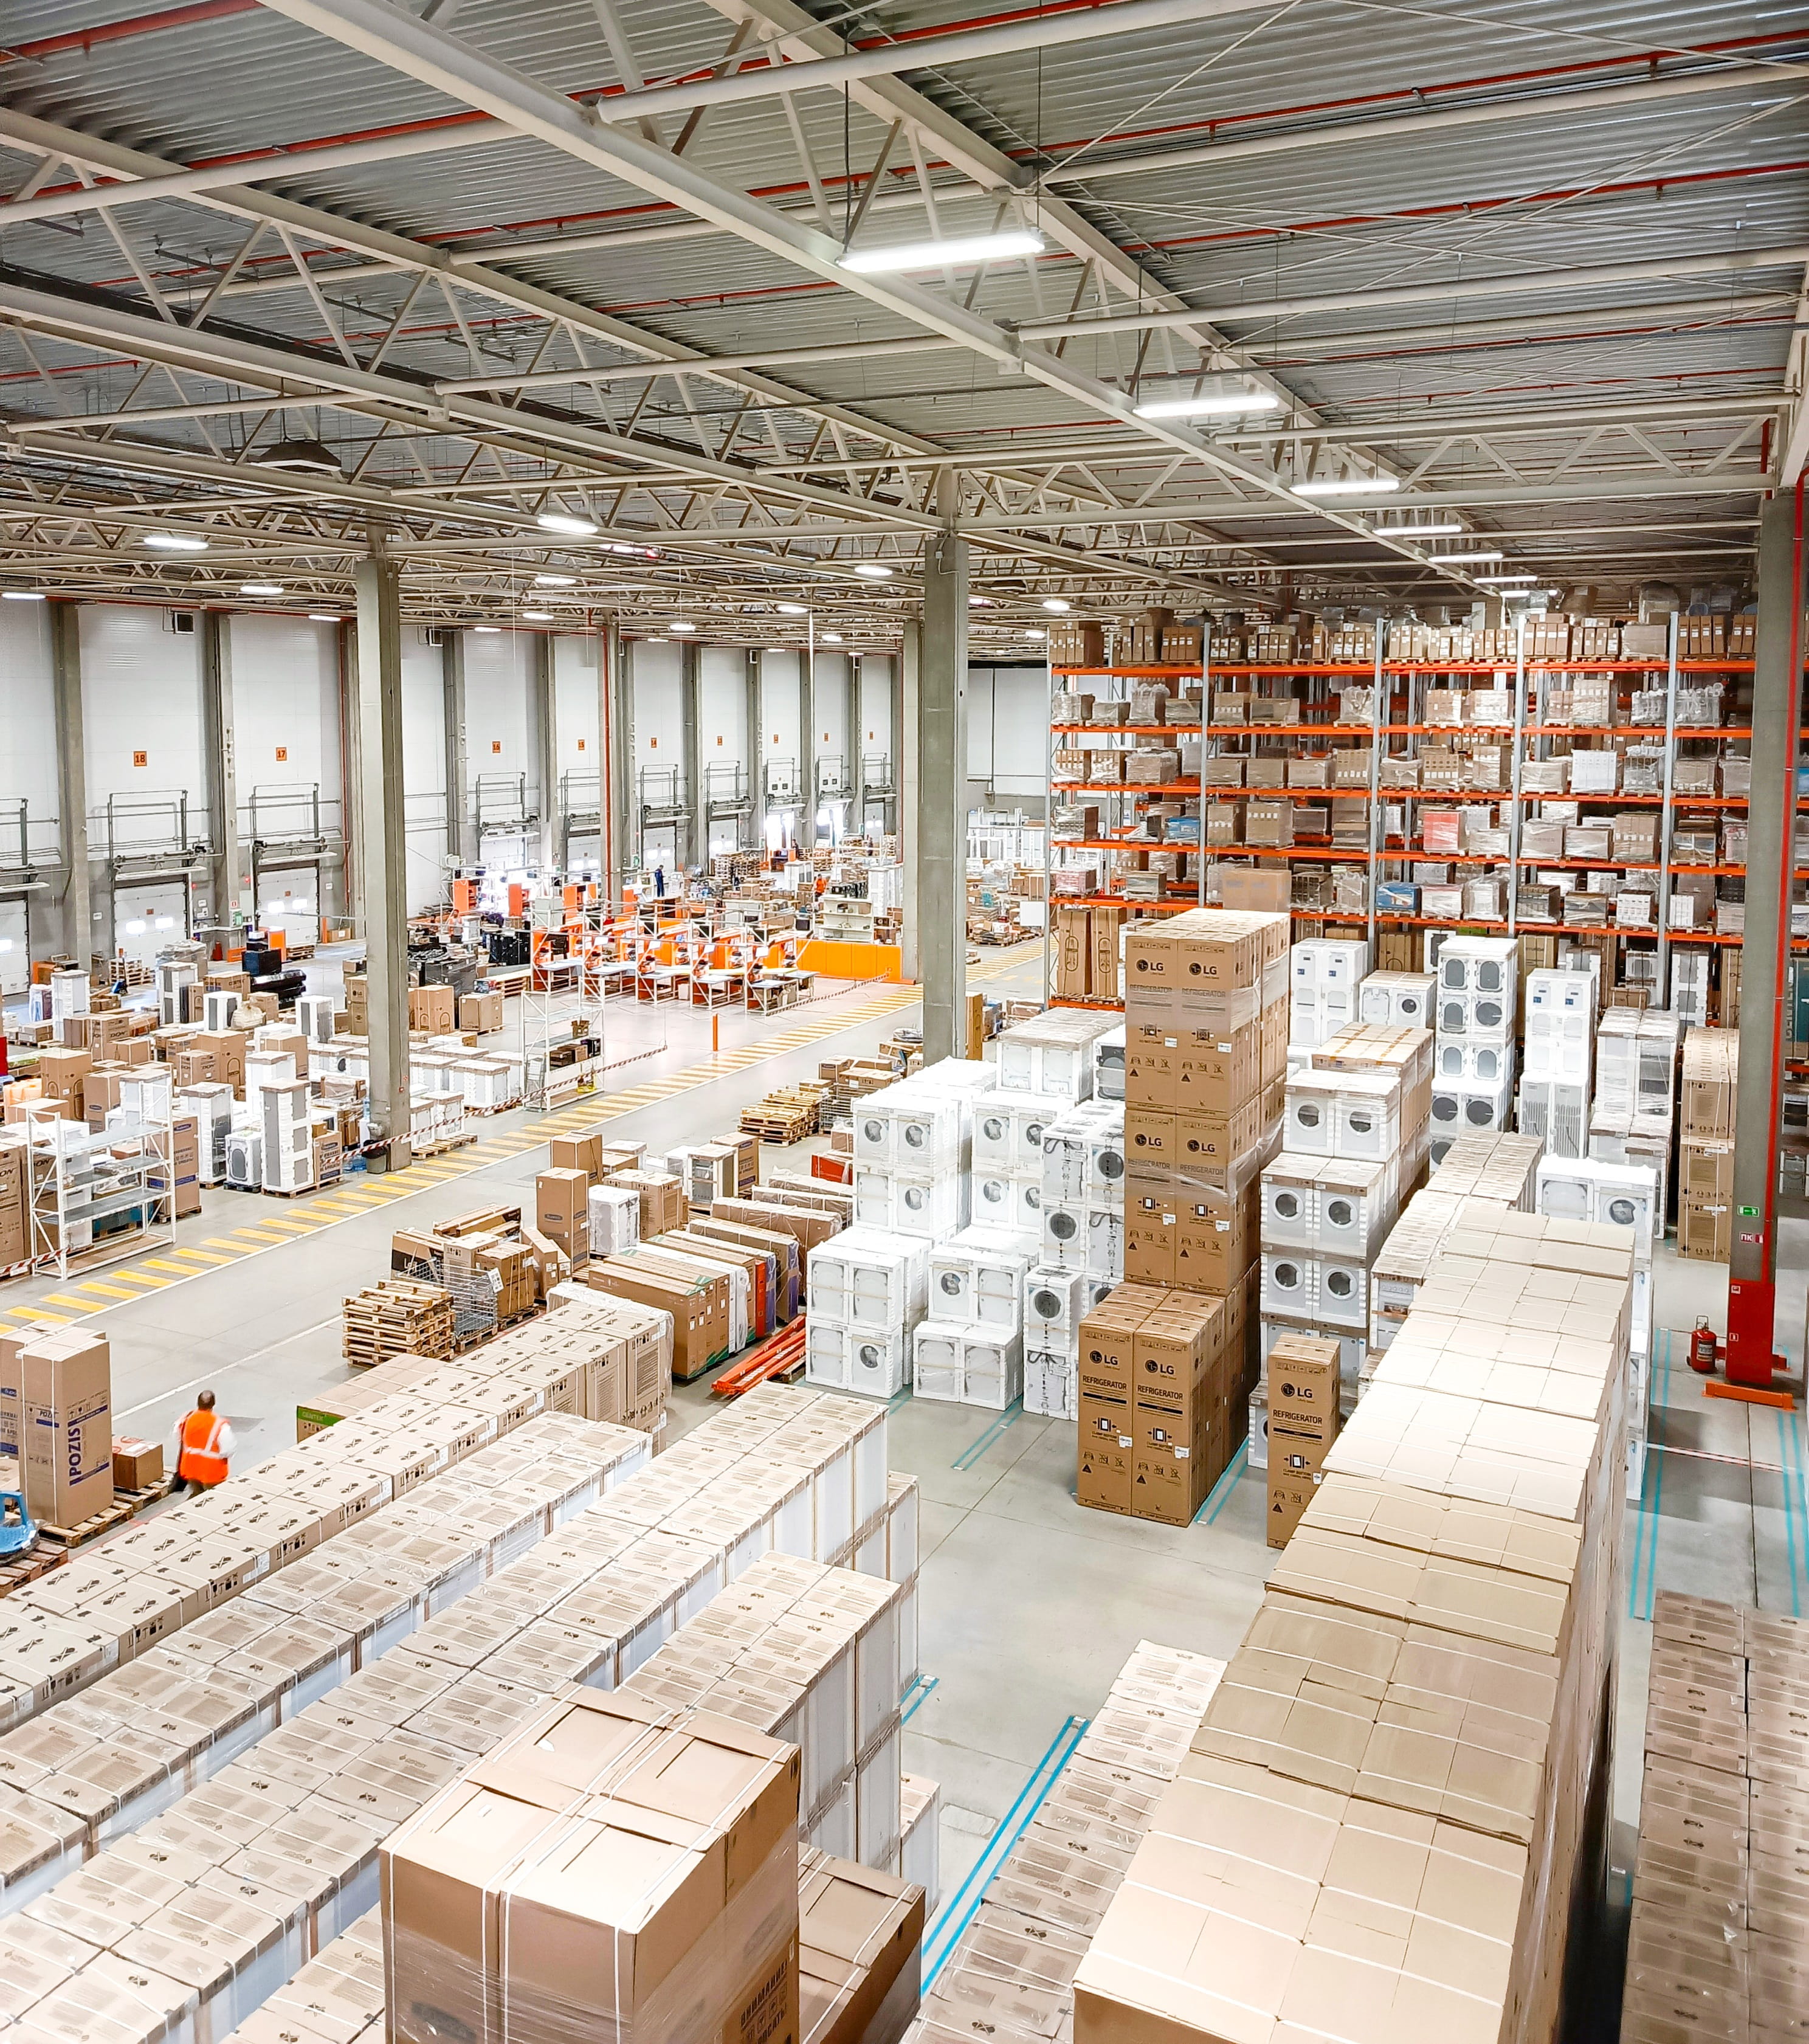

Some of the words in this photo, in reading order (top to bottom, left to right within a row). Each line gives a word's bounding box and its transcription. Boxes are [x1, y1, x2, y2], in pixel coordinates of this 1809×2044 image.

[135, 754, 145, 763] 18
[1150, 962, 1163, 971] LG
[1204, 965, 1217, 975] LG
[1182, 988, 1225, 998] REFRIGERATOR
[1148, 1137, 1162, 1146] LG
[1201, 1143, 1215, 1152] LG
[1180, 1164, 1224, 1175] REFRIGERATOR
[1104, 1355, 1118, 1366] LG
[1160, 1364, 1174, 1375] LG
[1083, 1375, 1127, 1390] REFRIGERATOR
[1137, 1384, 1183, 1400] REFRIGERATOR
[1297, 1387, 1313, 1398] LG
[1273, 1409, 1322, 1424] REFRIGERATOR
[67, 1428, 81, 1477] POZIS
[740, 1959, 788, 2028] ВНИМАНИЕ!
